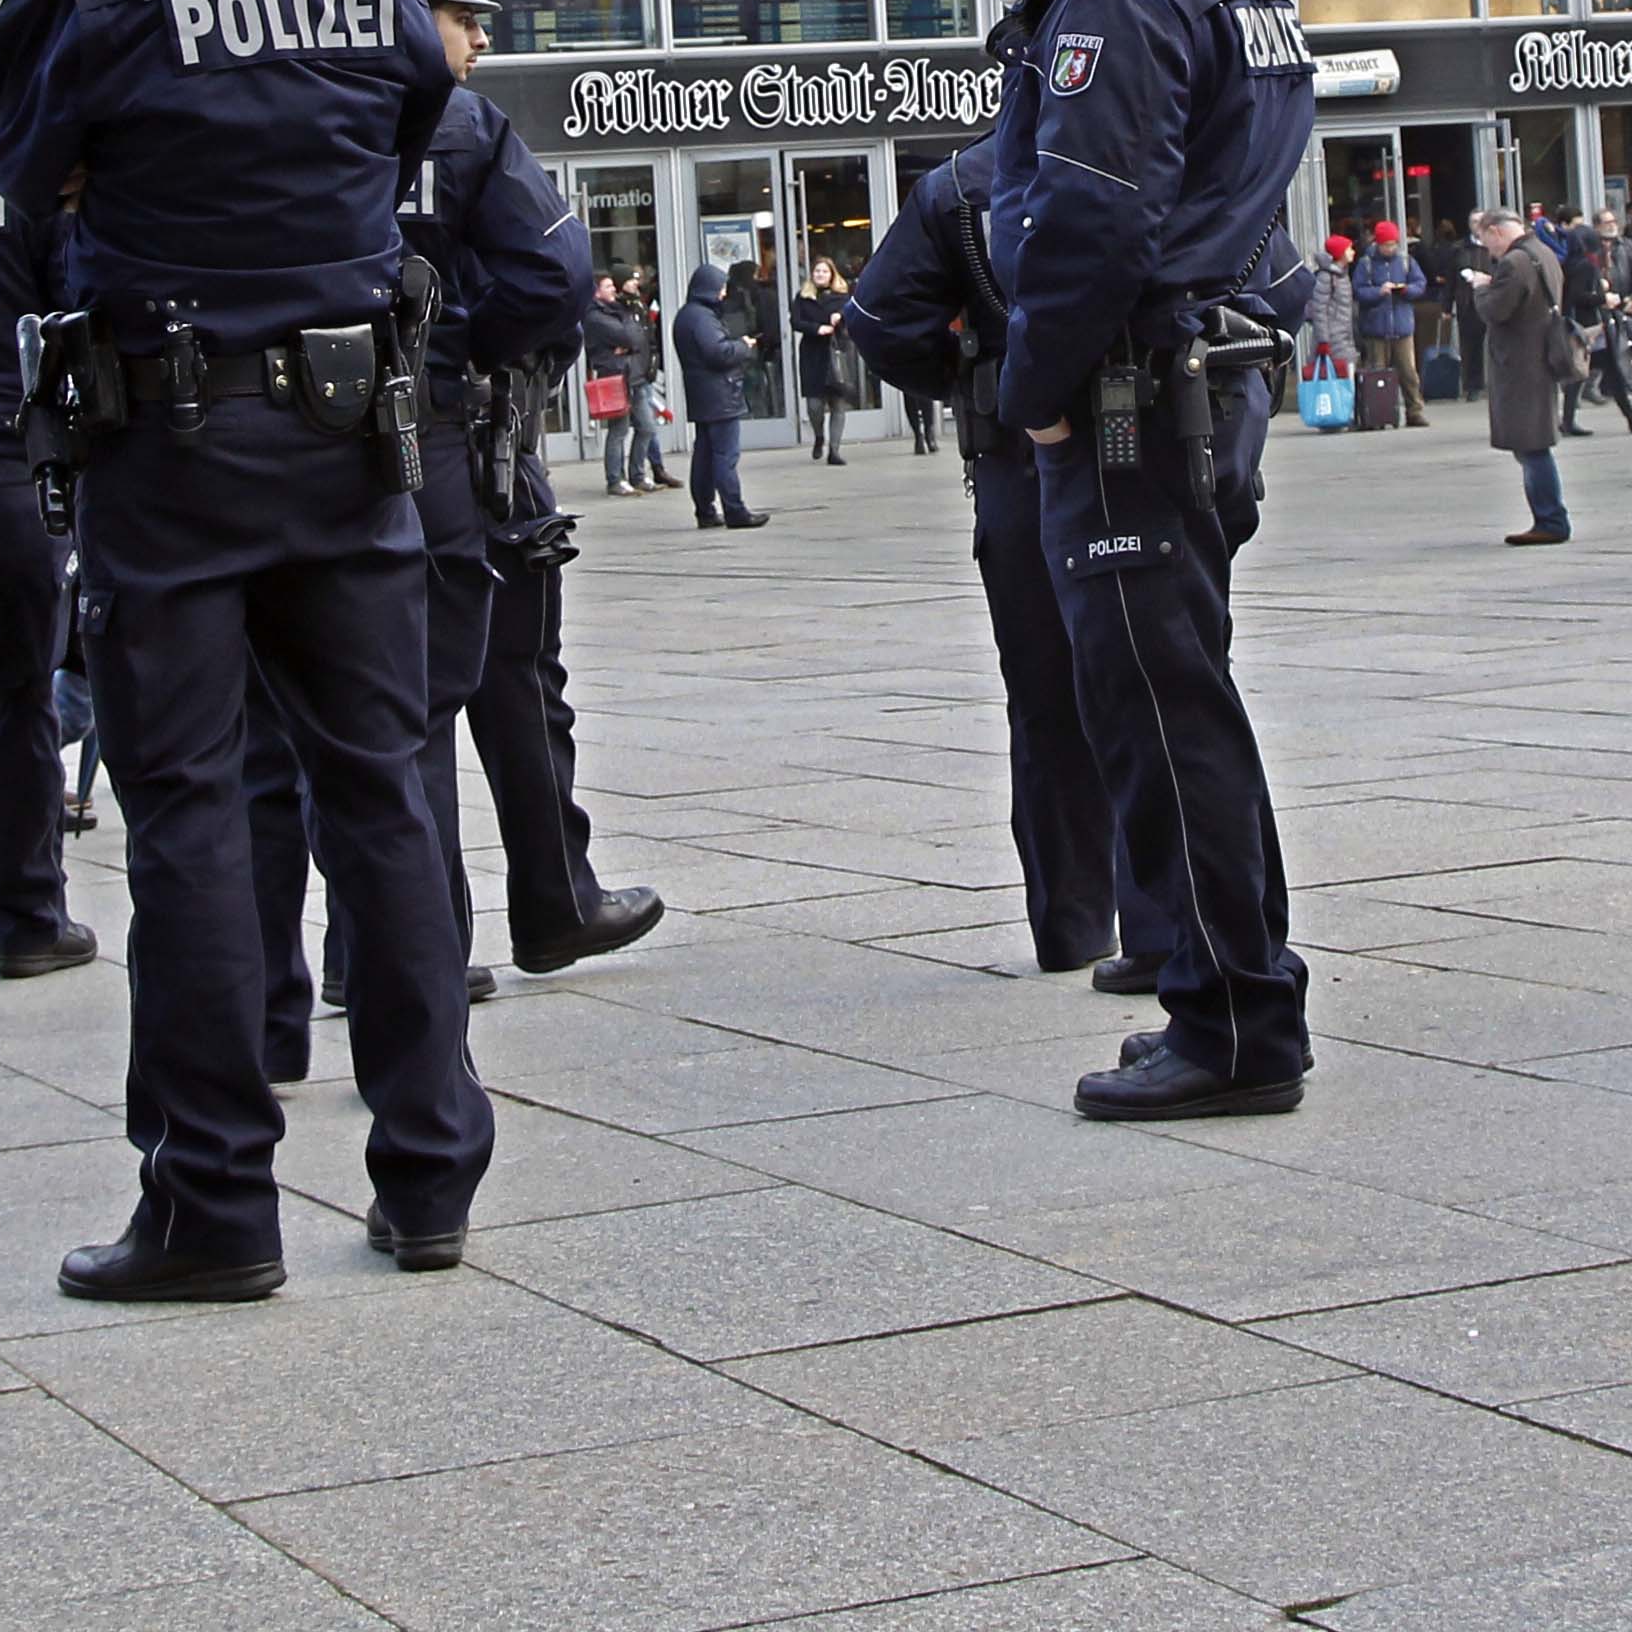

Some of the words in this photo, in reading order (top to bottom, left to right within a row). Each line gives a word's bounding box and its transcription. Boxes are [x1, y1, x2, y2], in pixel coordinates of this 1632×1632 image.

[1059, 37, 1100, 49] POLIZEI
[564, 68, 733, 138] Kölner
[740, 57, 1006, 128] Stadt-Anze
[586, 189, 653, 209] ormatio
[1088, 535, 1142, 559] POLIZEI
